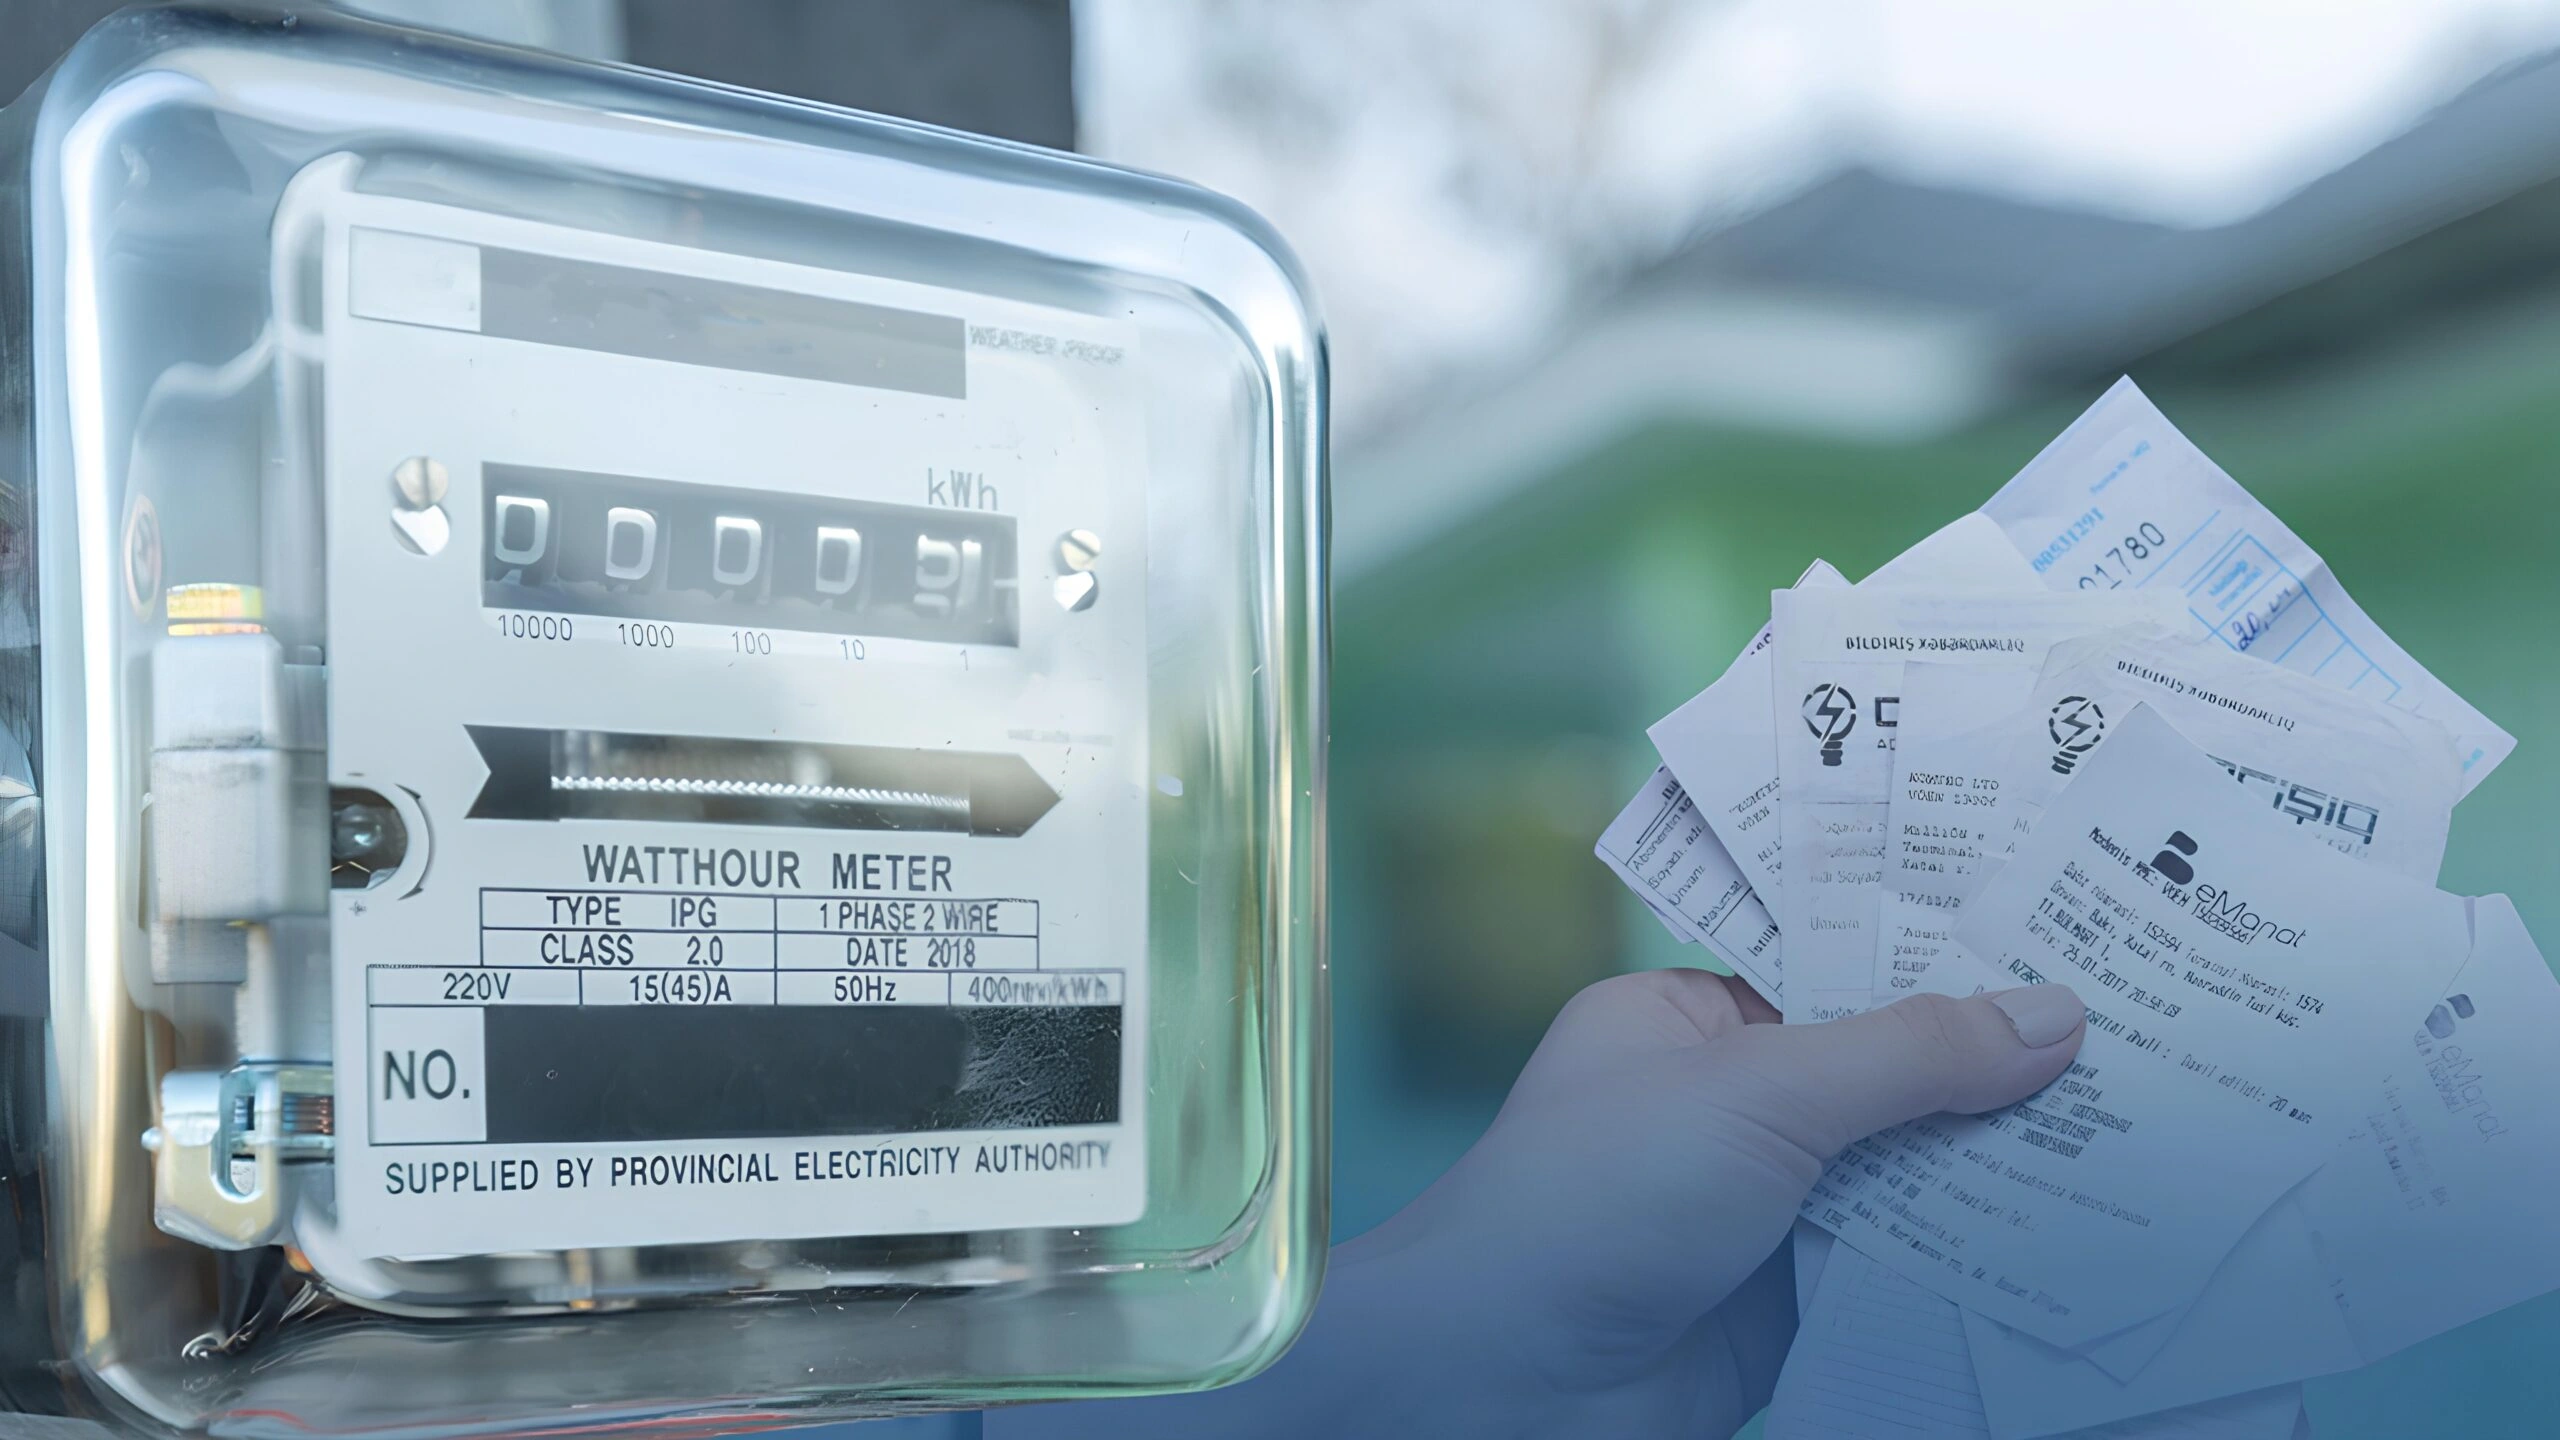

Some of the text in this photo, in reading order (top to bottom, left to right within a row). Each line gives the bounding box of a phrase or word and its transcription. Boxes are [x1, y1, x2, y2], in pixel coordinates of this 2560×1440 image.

[928, 467, 998, 511] kWh
[497, 614, 573, 642] 10000
[617, 622, 674, 648] 1000
[731, 631, 771, 655] 100
[840, 638, 866, 661] 10
[959, 648, 969, 671] 1
[583, 843, 952, 891] WATTHOUR METER
[547, 896, 717, 927] TYPE IPG
[819, 901, 999, 933] 1 PHASE 2 WIRE
[2195, 884, 2307, 949] eManat
[541, 934, 723, 966] CLASS 2.0
[847, 938, 976, 968] DATE 2018
[443, 972, 512, 1001] 220V
[630, 972, 731, 1004] 15(45)A
[834, 975, 897, 1003] 50Hz
[384, 1049, 470, 1101] NO.
[386, 1140, 1110, 1194] SUPPLIED BY PROVINCIAL ELECTRICITY AUTHORITY
